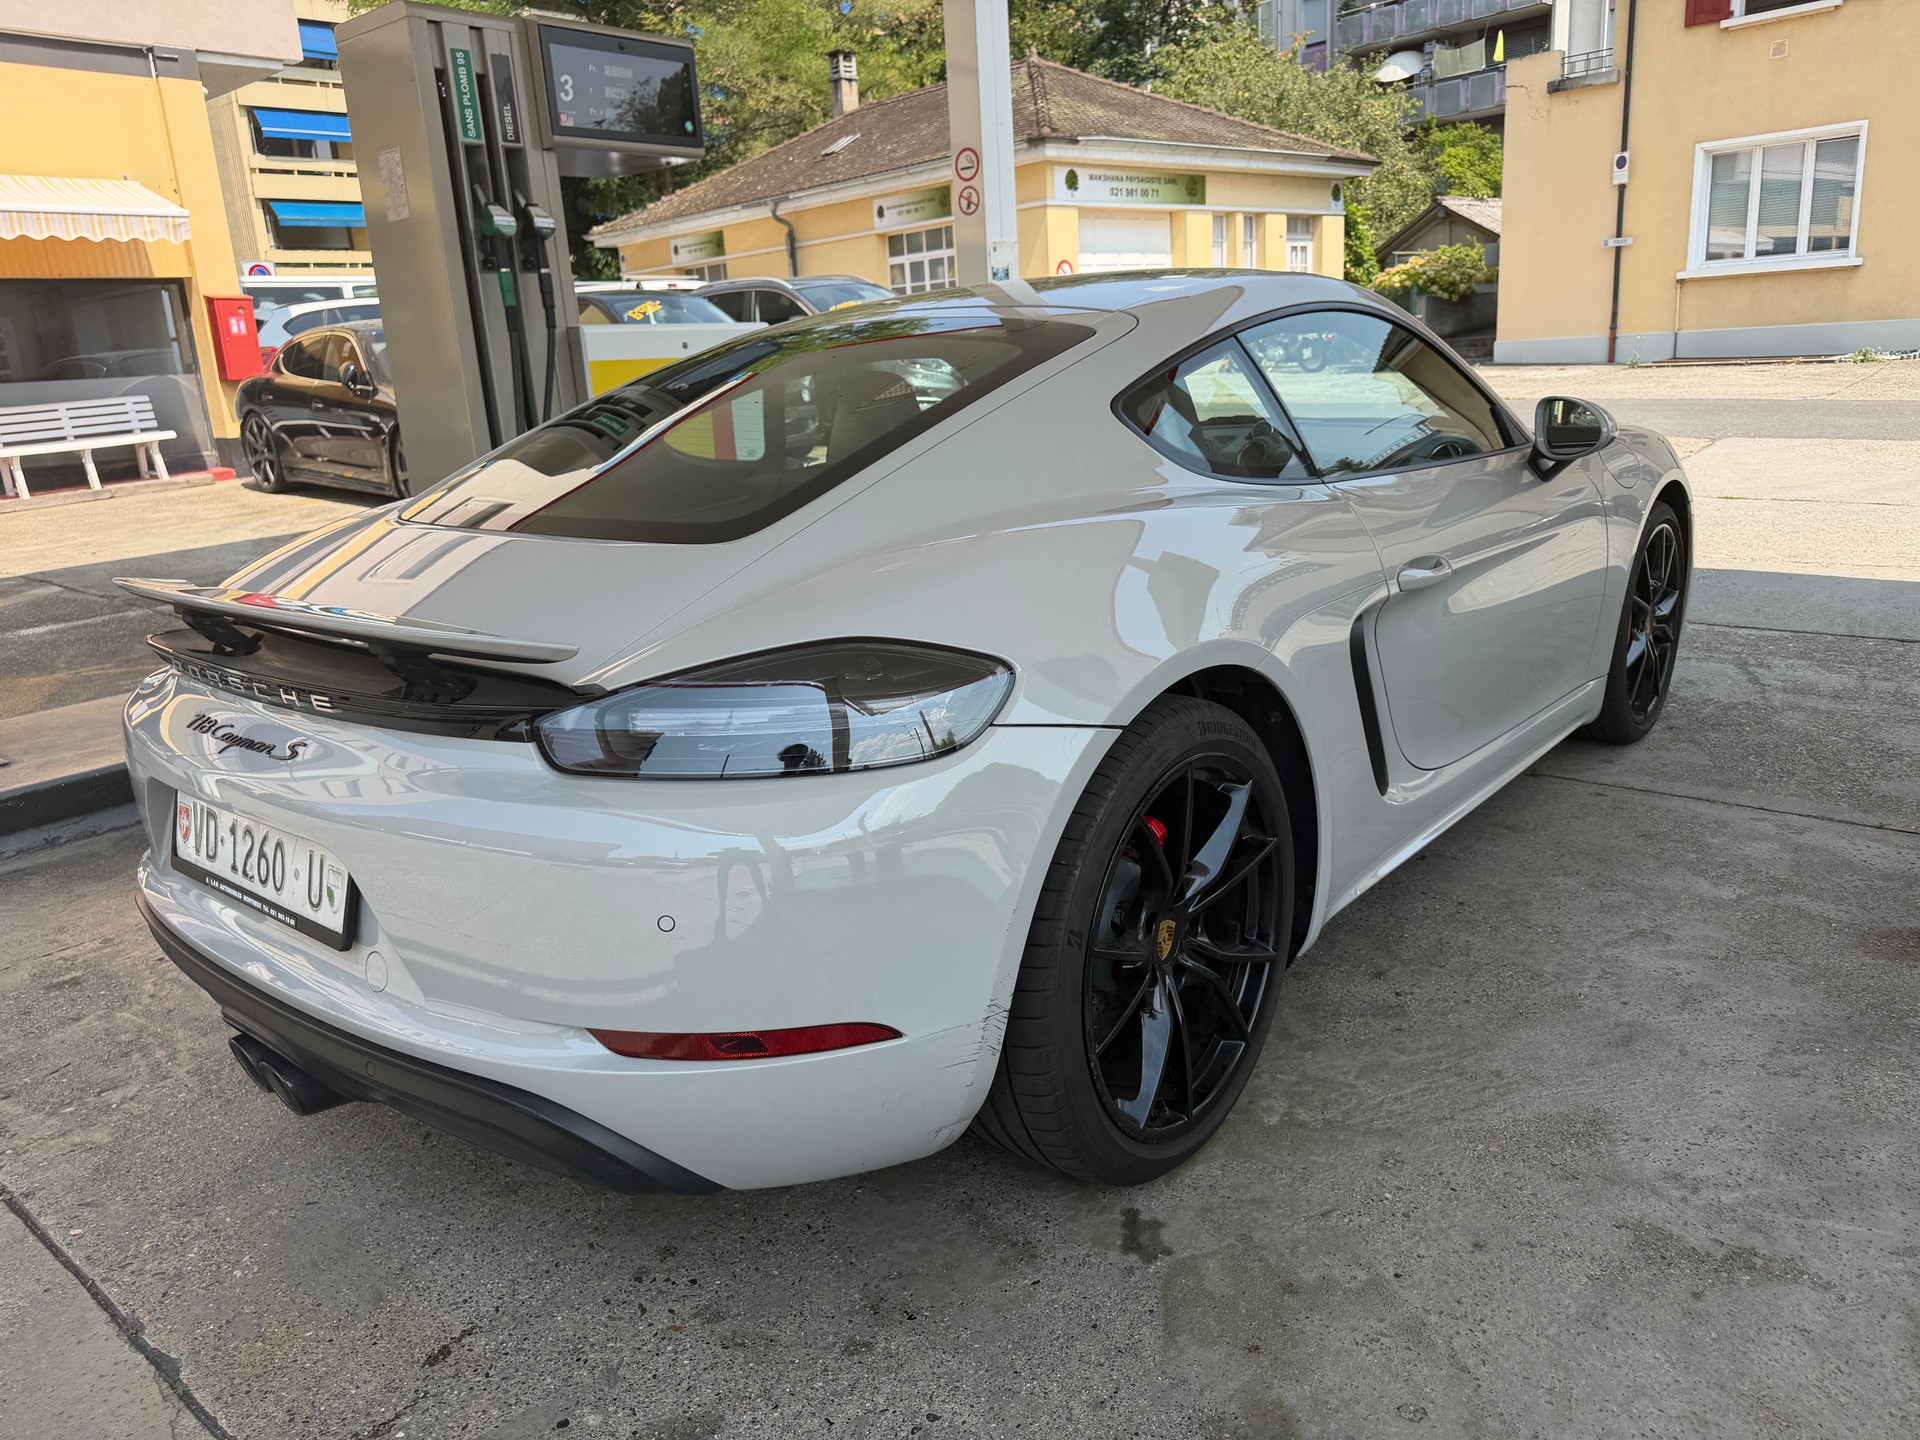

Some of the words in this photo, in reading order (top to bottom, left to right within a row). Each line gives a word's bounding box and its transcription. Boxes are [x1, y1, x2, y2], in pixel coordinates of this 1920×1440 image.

[456, 51, 466, 65] 95
[458, 66, 472, 106] PLOMB
[560, 74, 574, 101] 3
[465, 108, 476, 138] SANS
[503, 102, 515, 140] DIESEL
[1109, 187, 1123, 197] 021
[1150, 188, 1160, 198] 71
[171, 658, 343, 714] PORSCHE
[186, 713, 218, 734] 718
[210, 723, 277, 754] Cayman
[268, 741, 308, 761] S
[1197, 720, 1259, 751] BRIDGESTONE
[193, 801, 219, 862] VD
[229, 816, 286, 896] 1260
[307, 849, 326, 912] U
